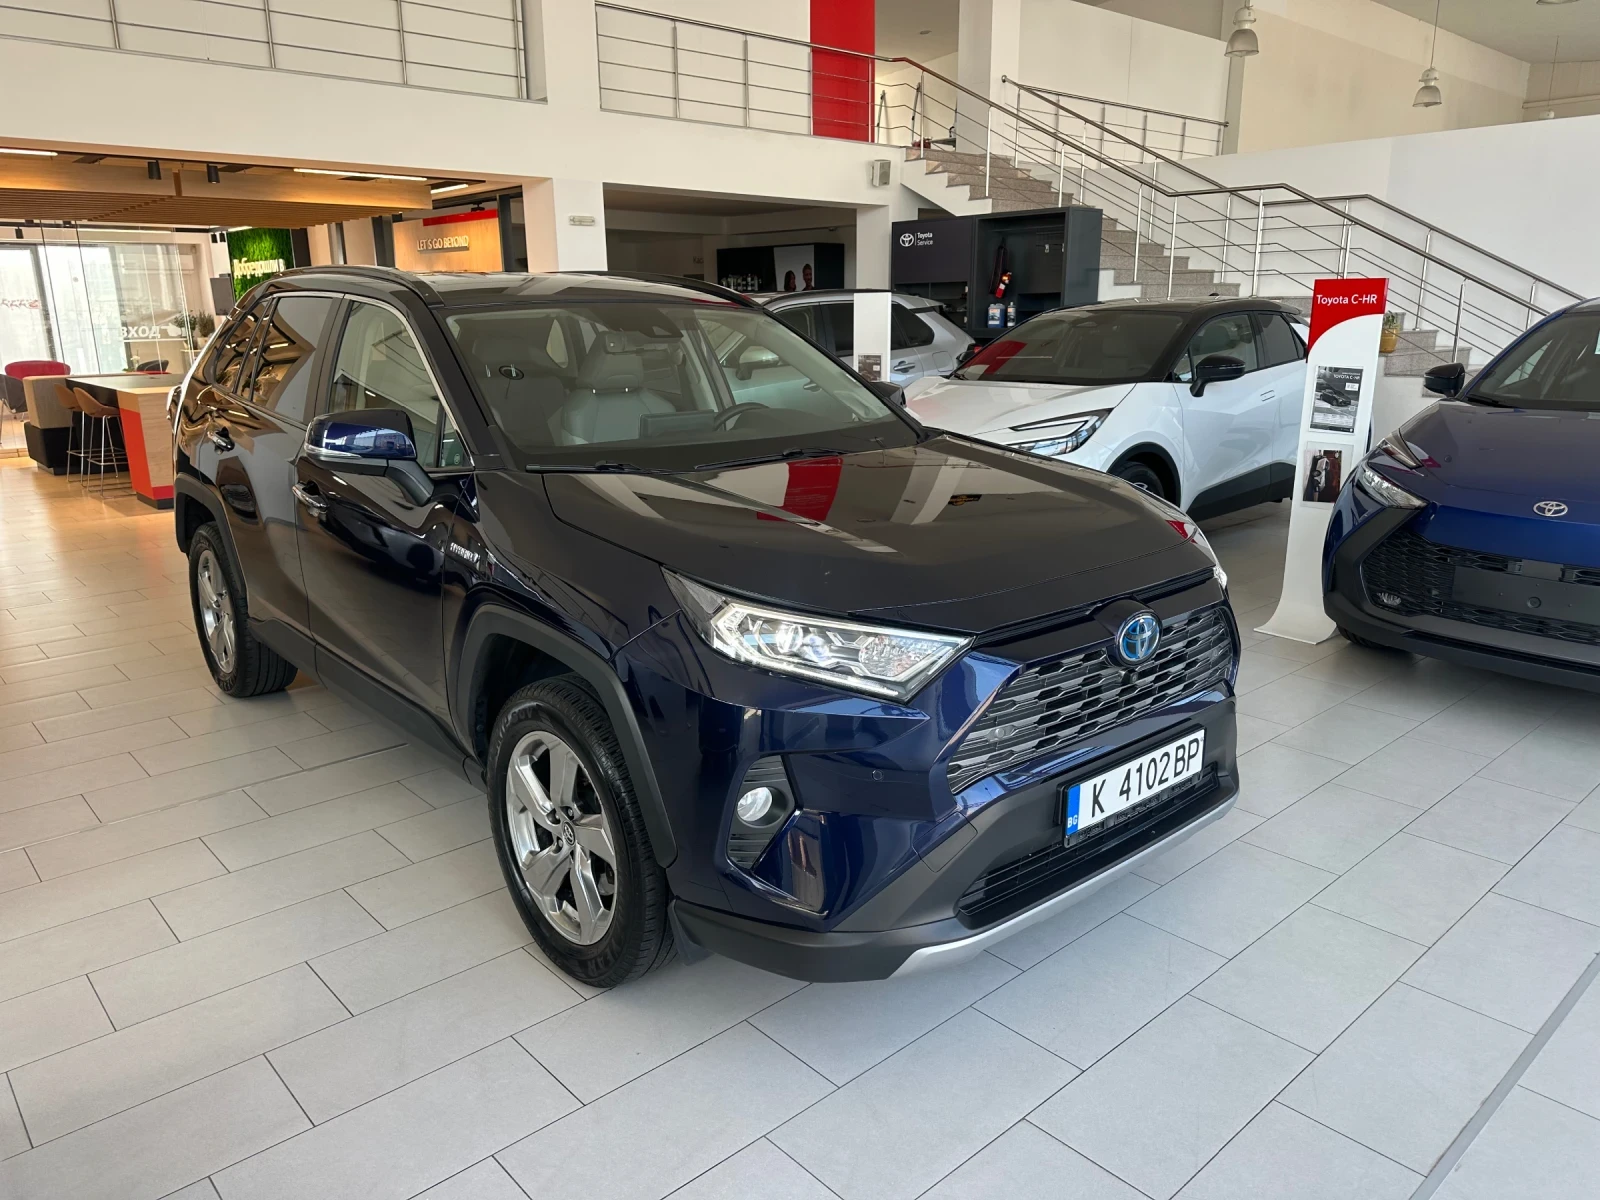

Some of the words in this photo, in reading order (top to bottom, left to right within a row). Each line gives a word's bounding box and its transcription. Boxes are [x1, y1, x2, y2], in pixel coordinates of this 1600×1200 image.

[432, 238, 443, 249] GO
[443, 235, 469, 248] BEYOND
[1316, 294, 1349, 307] Toyota
[1351, 294, 1378, 304] C-HR
[1092, 779, 1106, 818] K
[1067, 815, 1078, 829] BG
